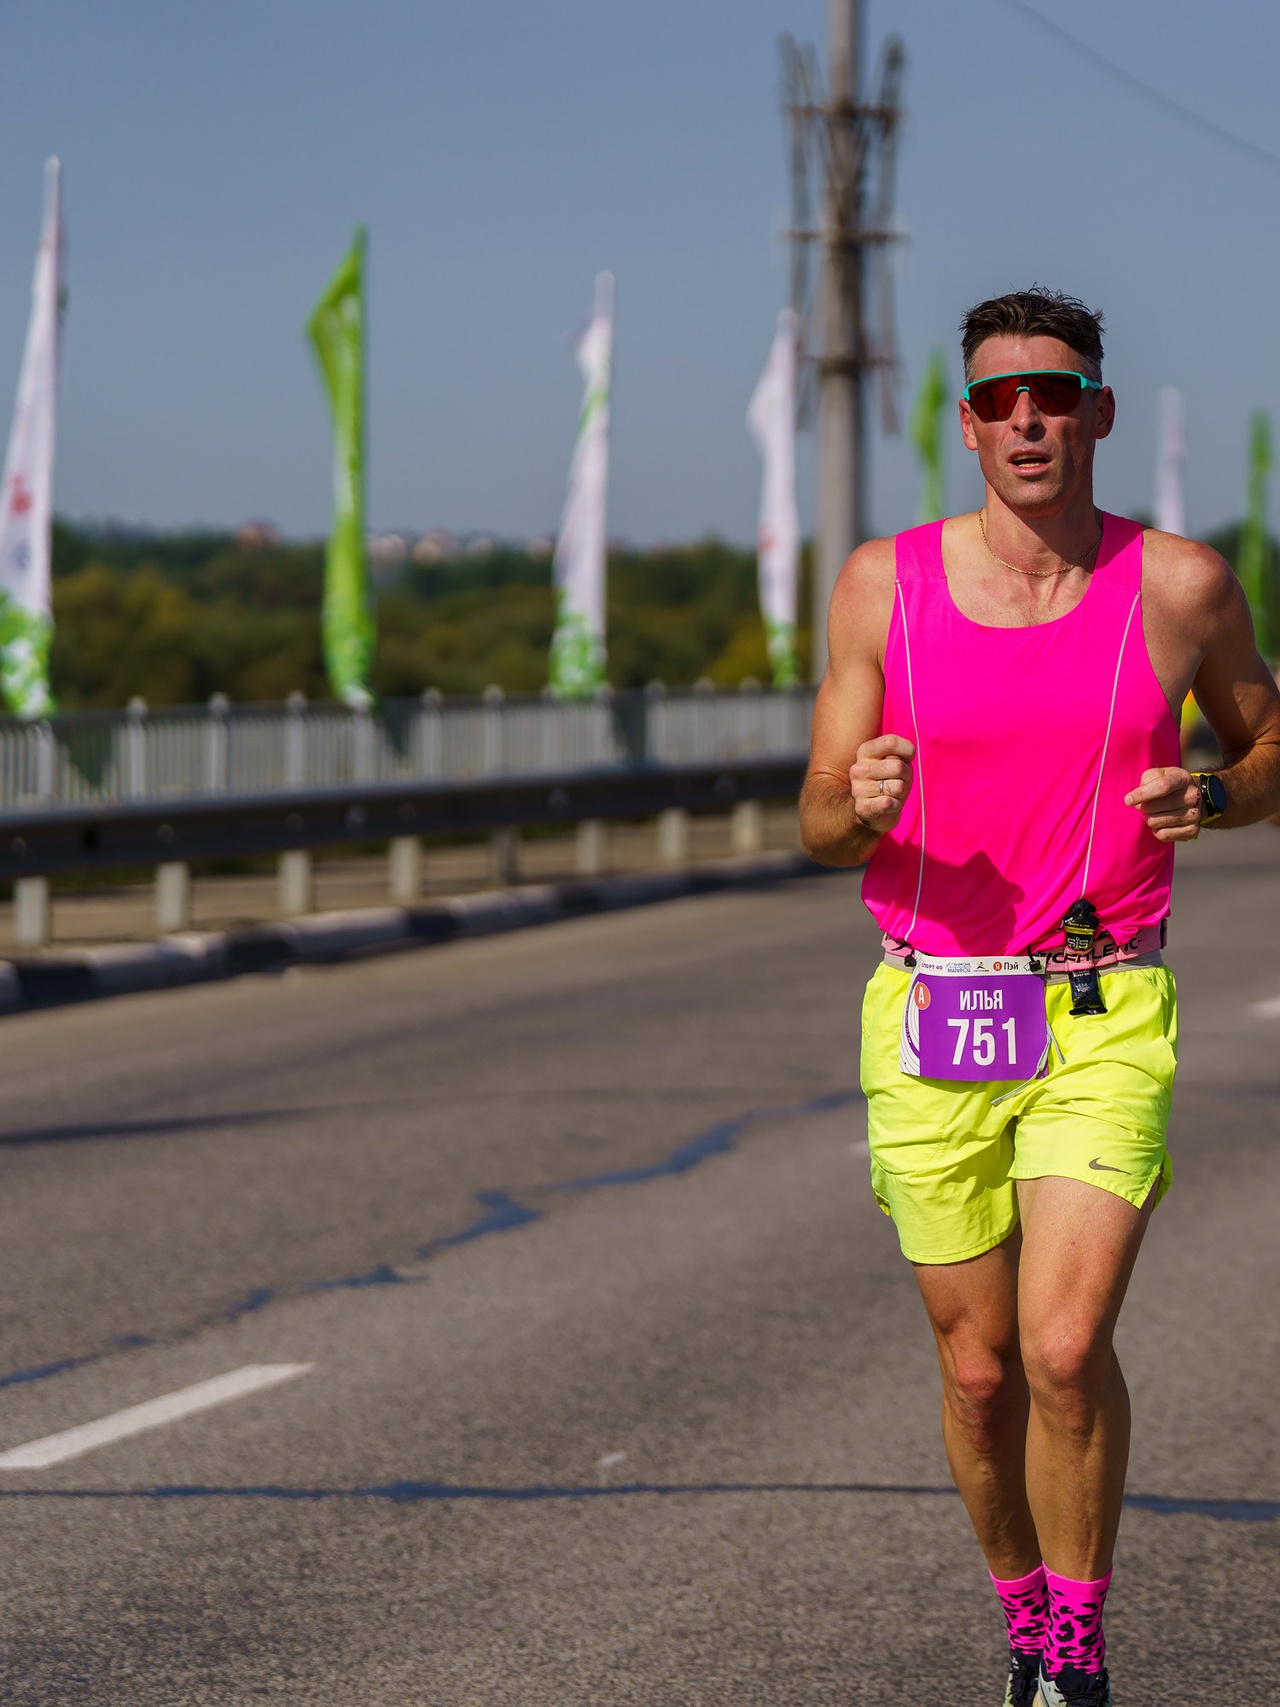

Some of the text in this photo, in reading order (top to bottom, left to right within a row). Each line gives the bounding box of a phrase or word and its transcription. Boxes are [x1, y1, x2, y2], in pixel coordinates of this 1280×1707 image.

[1004, 961, 1019, 971] Пэй
[959, 989, 1003, 1011] ИЛЬЯ
[947, 1017, 1017, 1066] 751
